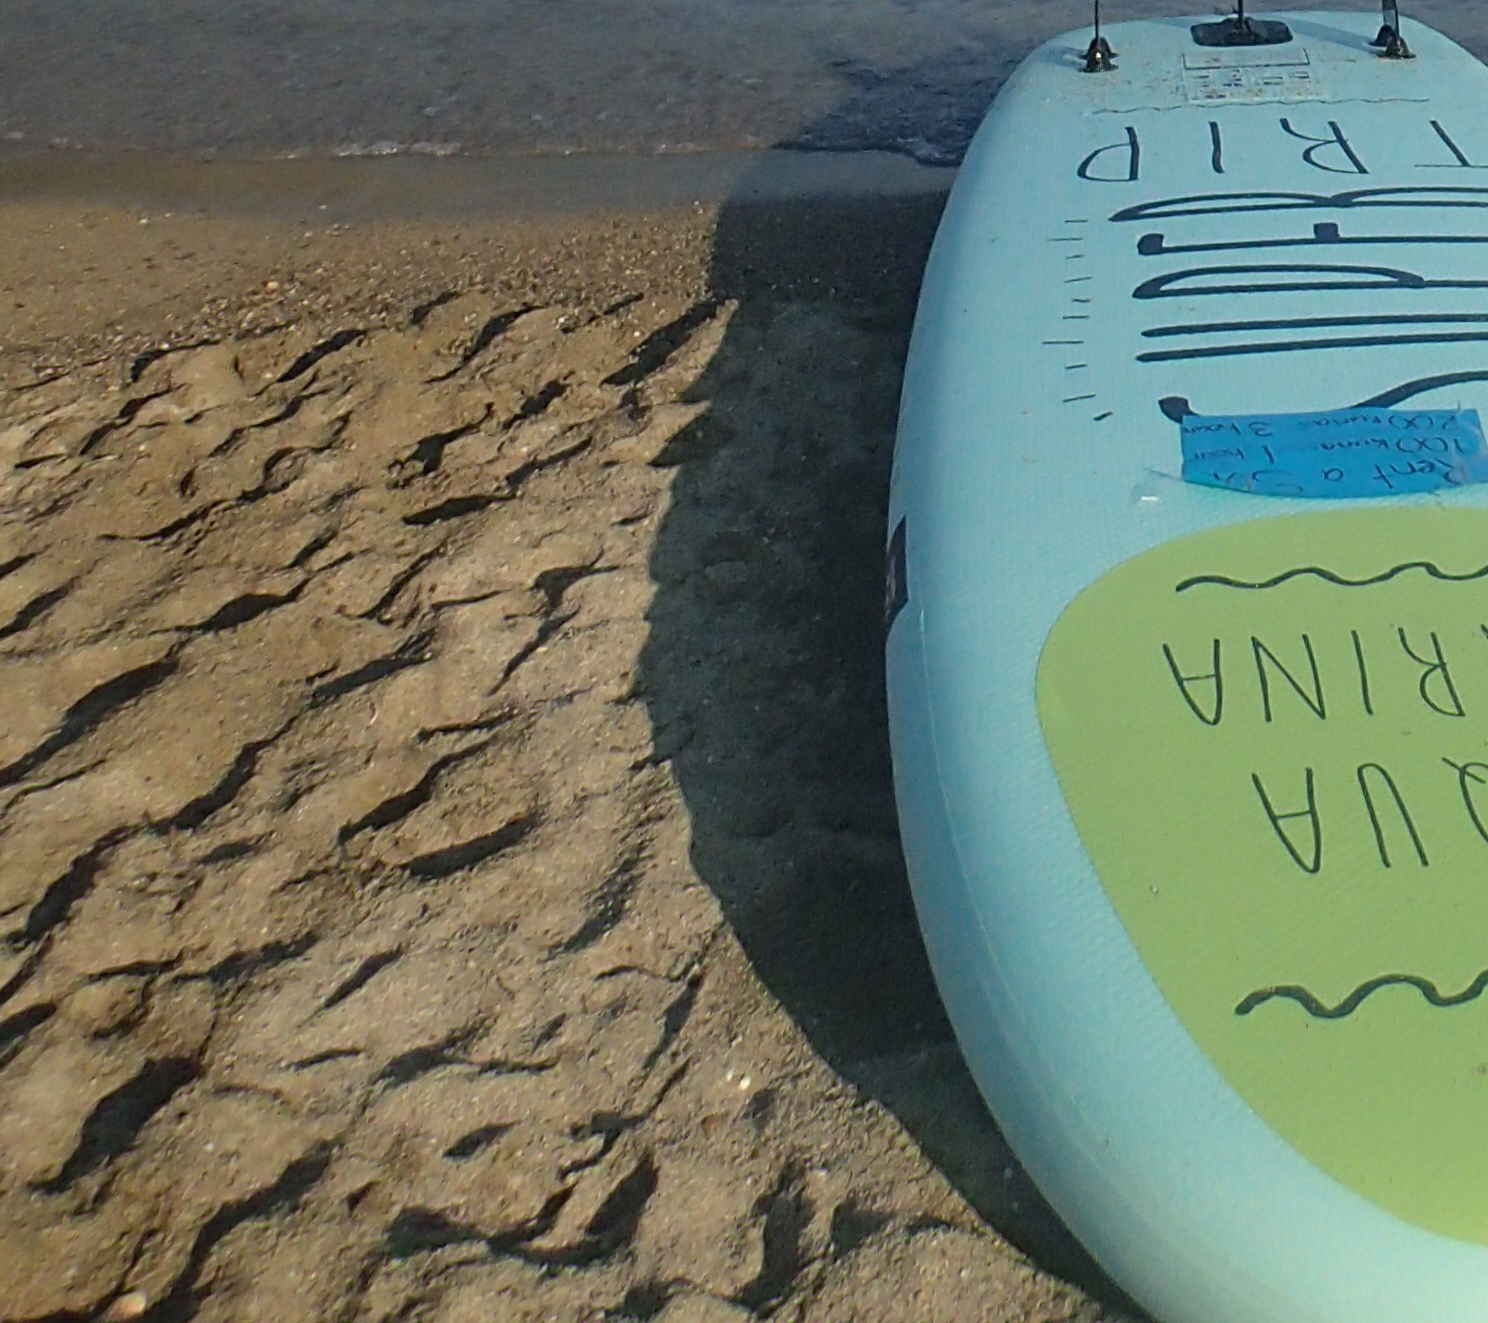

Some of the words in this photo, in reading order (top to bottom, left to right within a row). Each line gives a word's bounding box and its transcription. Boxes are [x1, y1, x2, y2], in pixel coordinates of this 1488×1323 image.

[1249, 421, 1273, 437] 3
[1261, 444, 1275, 465] 1
[1322, 467, 1345, 483] a
[1372, 457, 1464, 490] Rent
